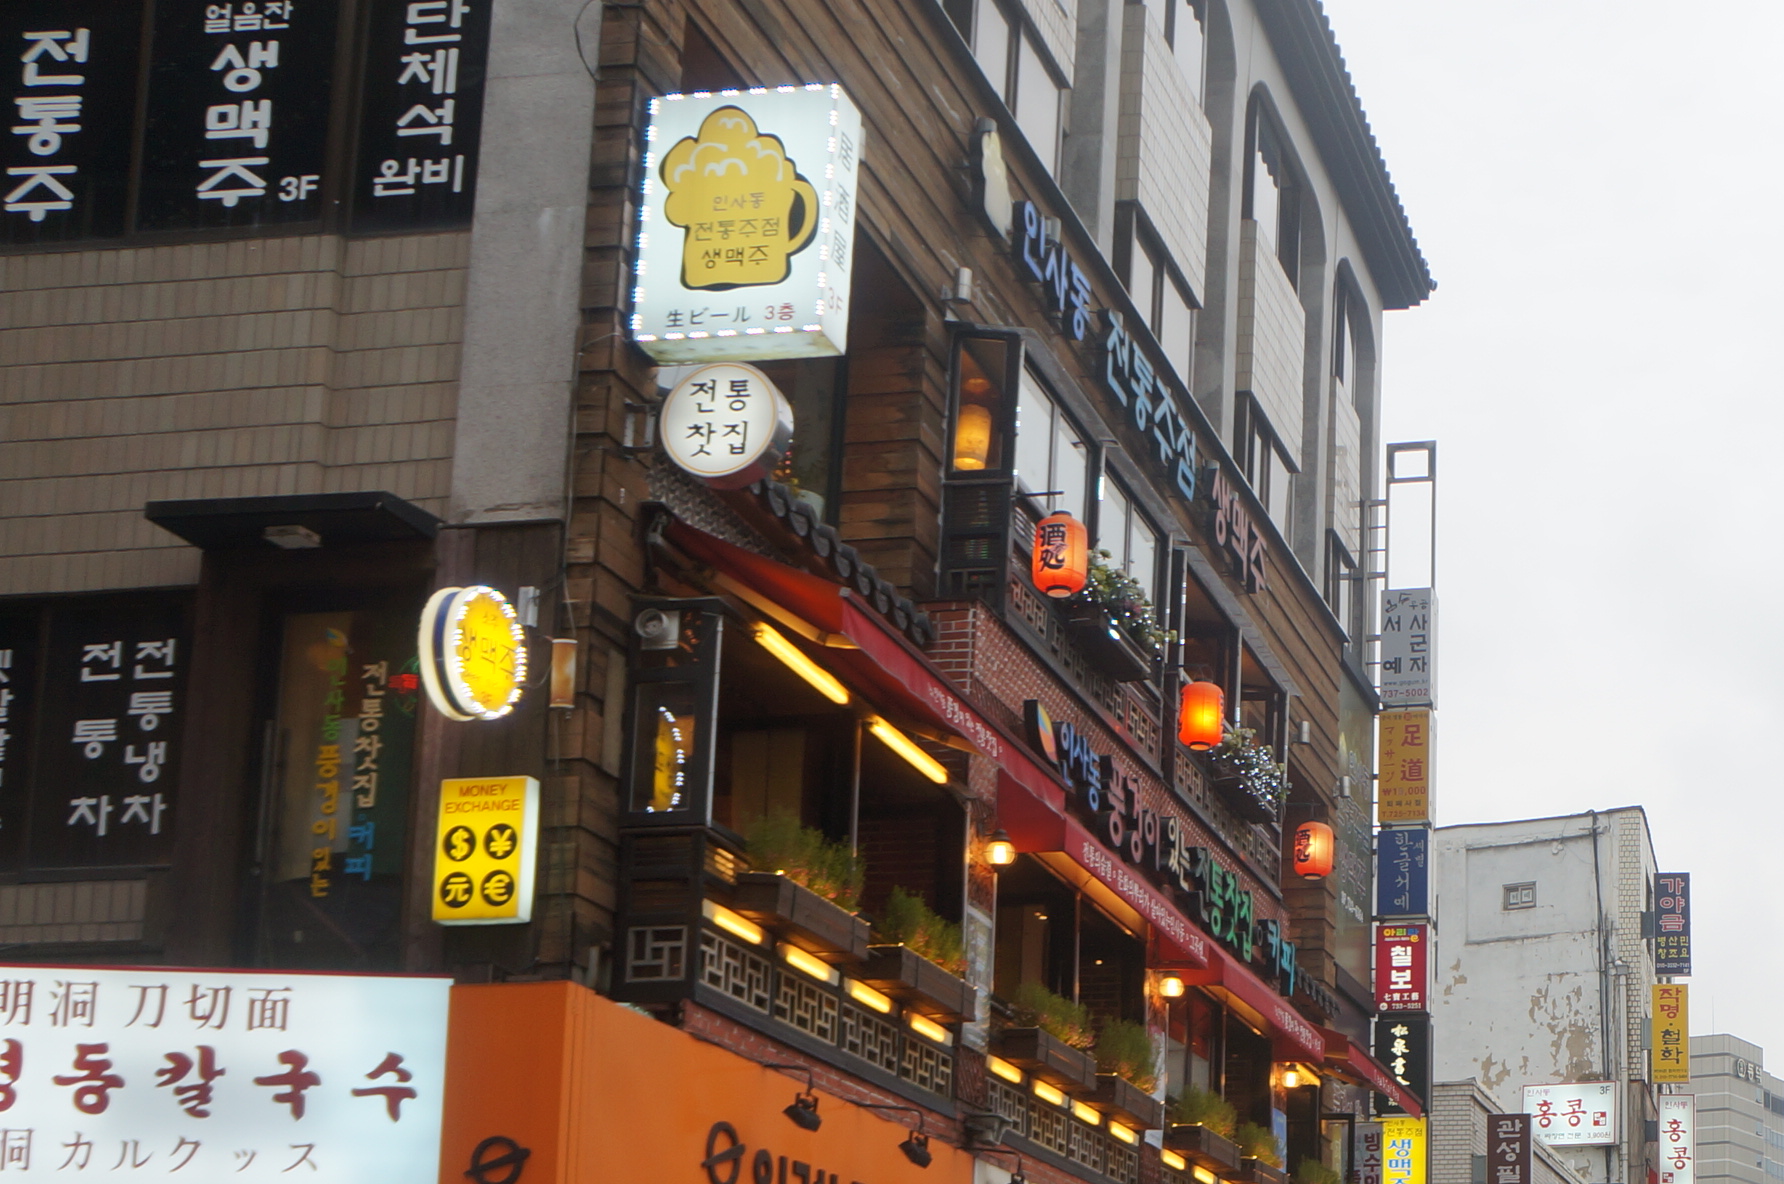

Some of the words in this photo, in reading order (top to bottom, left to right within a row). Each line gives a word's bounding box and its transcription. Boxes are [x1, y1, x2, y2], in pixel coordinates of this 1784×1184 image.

[204, 1, 293, 33] 얼음잔
[4, 28, 91, 222] 전통주
[197, 40, 279, 207] 생맥주
[278, 175, 320, 202] 3F
[373, 155, 465, 197] 완비
[713, 192, 765, 212] 인사동
[694, 217, 780, 242] 전통주점
[701, 245, 770, 269] 생맥주
[1022, 201, 1092, 341] 인사동
[665, 306, 750, 328] 生ビール
[690, 378, 752, 414] 전통
[1106, 310, 1197, 502] 전통주점
[685, 421, 750, 457] 찻집
[1212, 471, 1267, 594] 생맥주
[1383, 615, 1402, 674] 서예
[1408, 613, 1428, 673] 사군자
[1382, 687, 1429, 698] 737-5002
[67, 641, 124, 837] 전통차
[120, 638, 177, 836] 전통냉차
[1400, 723, 1424, 783] 足道
[458, 784, 509, 798] MONEY
[1059, 721, 1100, 812] 인사동
[444, 799, 520, 814] EXCHANGE
[1107, 758, 1161, 872] 풍경이
[1196, 848, 1254, 963] 전통찻집
[1658, 877, 1686, 932] 가야금
[1389, 945, 1412, 990] 칠보
[1532, 1098, 1588, 1128] 홍콩
[1599, 1086, 1611, 1095] 3F
[1661, 1118, 1692, 1170] 홍콩
